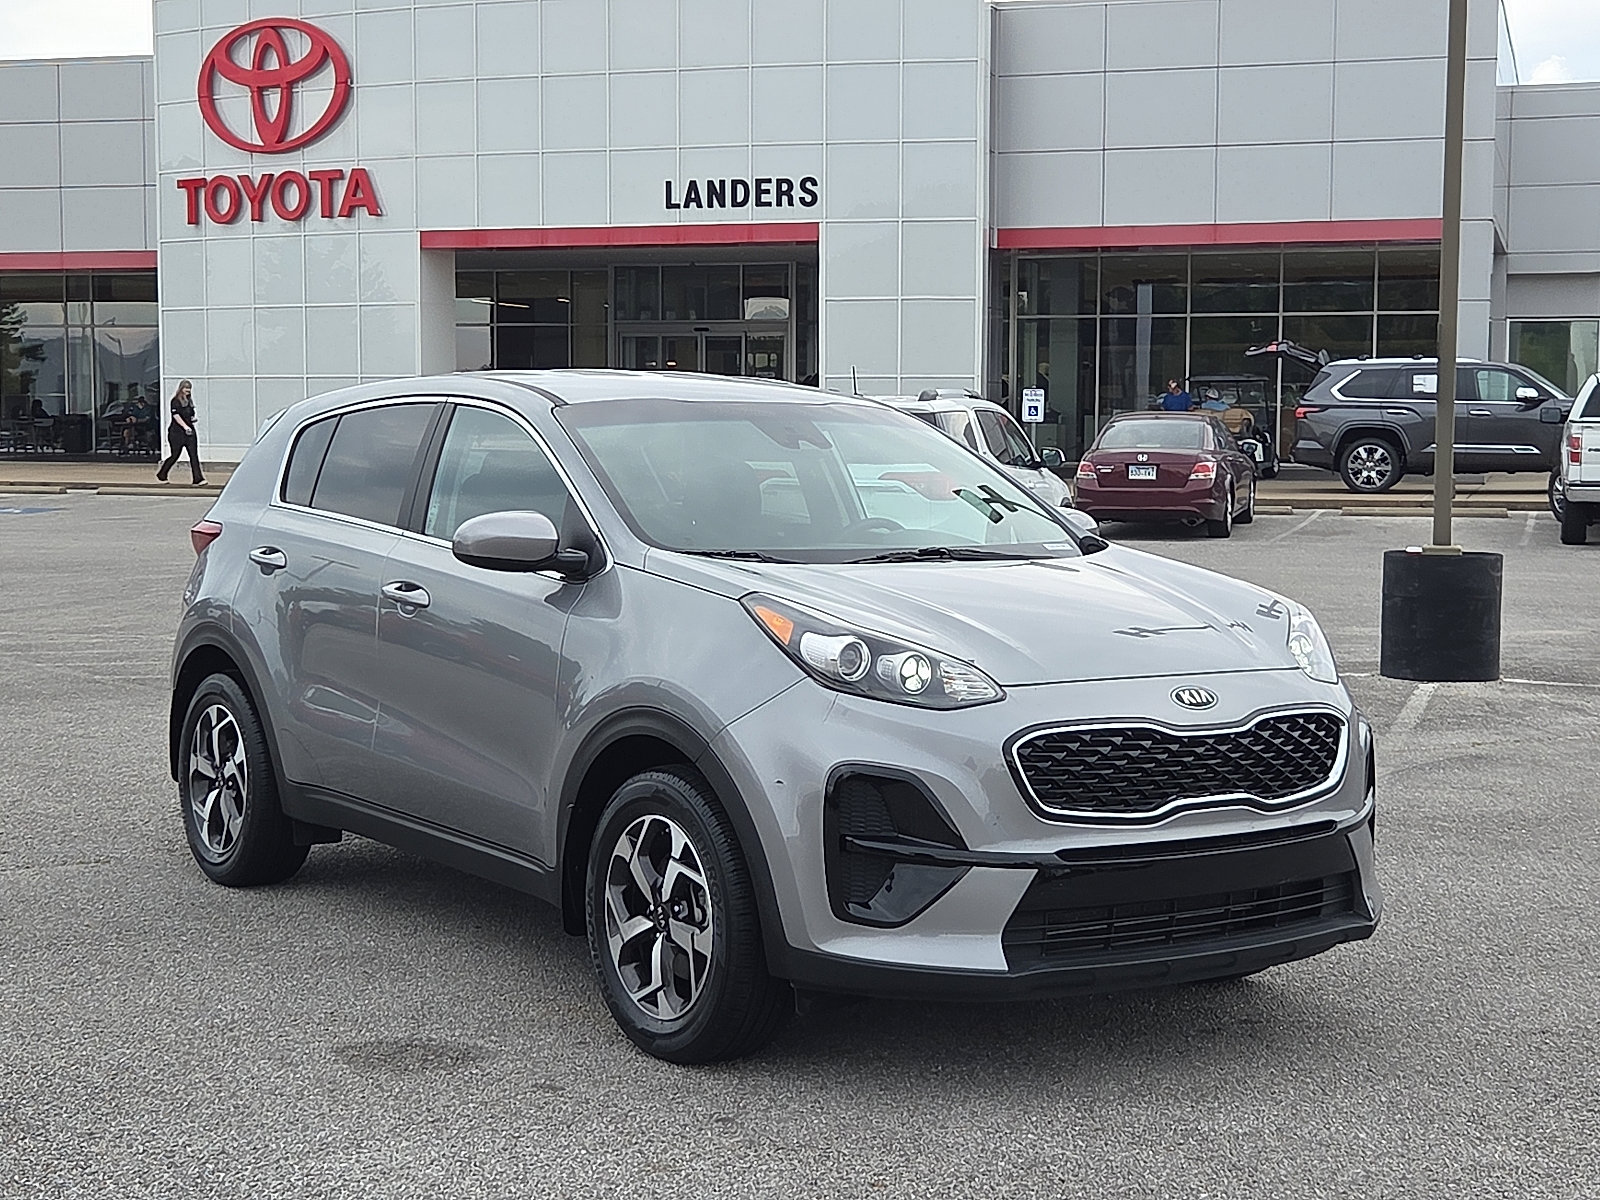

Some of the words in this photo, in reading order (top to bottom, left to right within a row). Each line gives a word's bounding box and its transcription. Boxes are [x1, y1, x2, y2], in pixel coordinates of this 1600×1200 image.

[177, 168, 382, 225] TOYOTA
[665, 177, 819, 209] LANDERS
[1178, 689, 1214, 704] KIA
